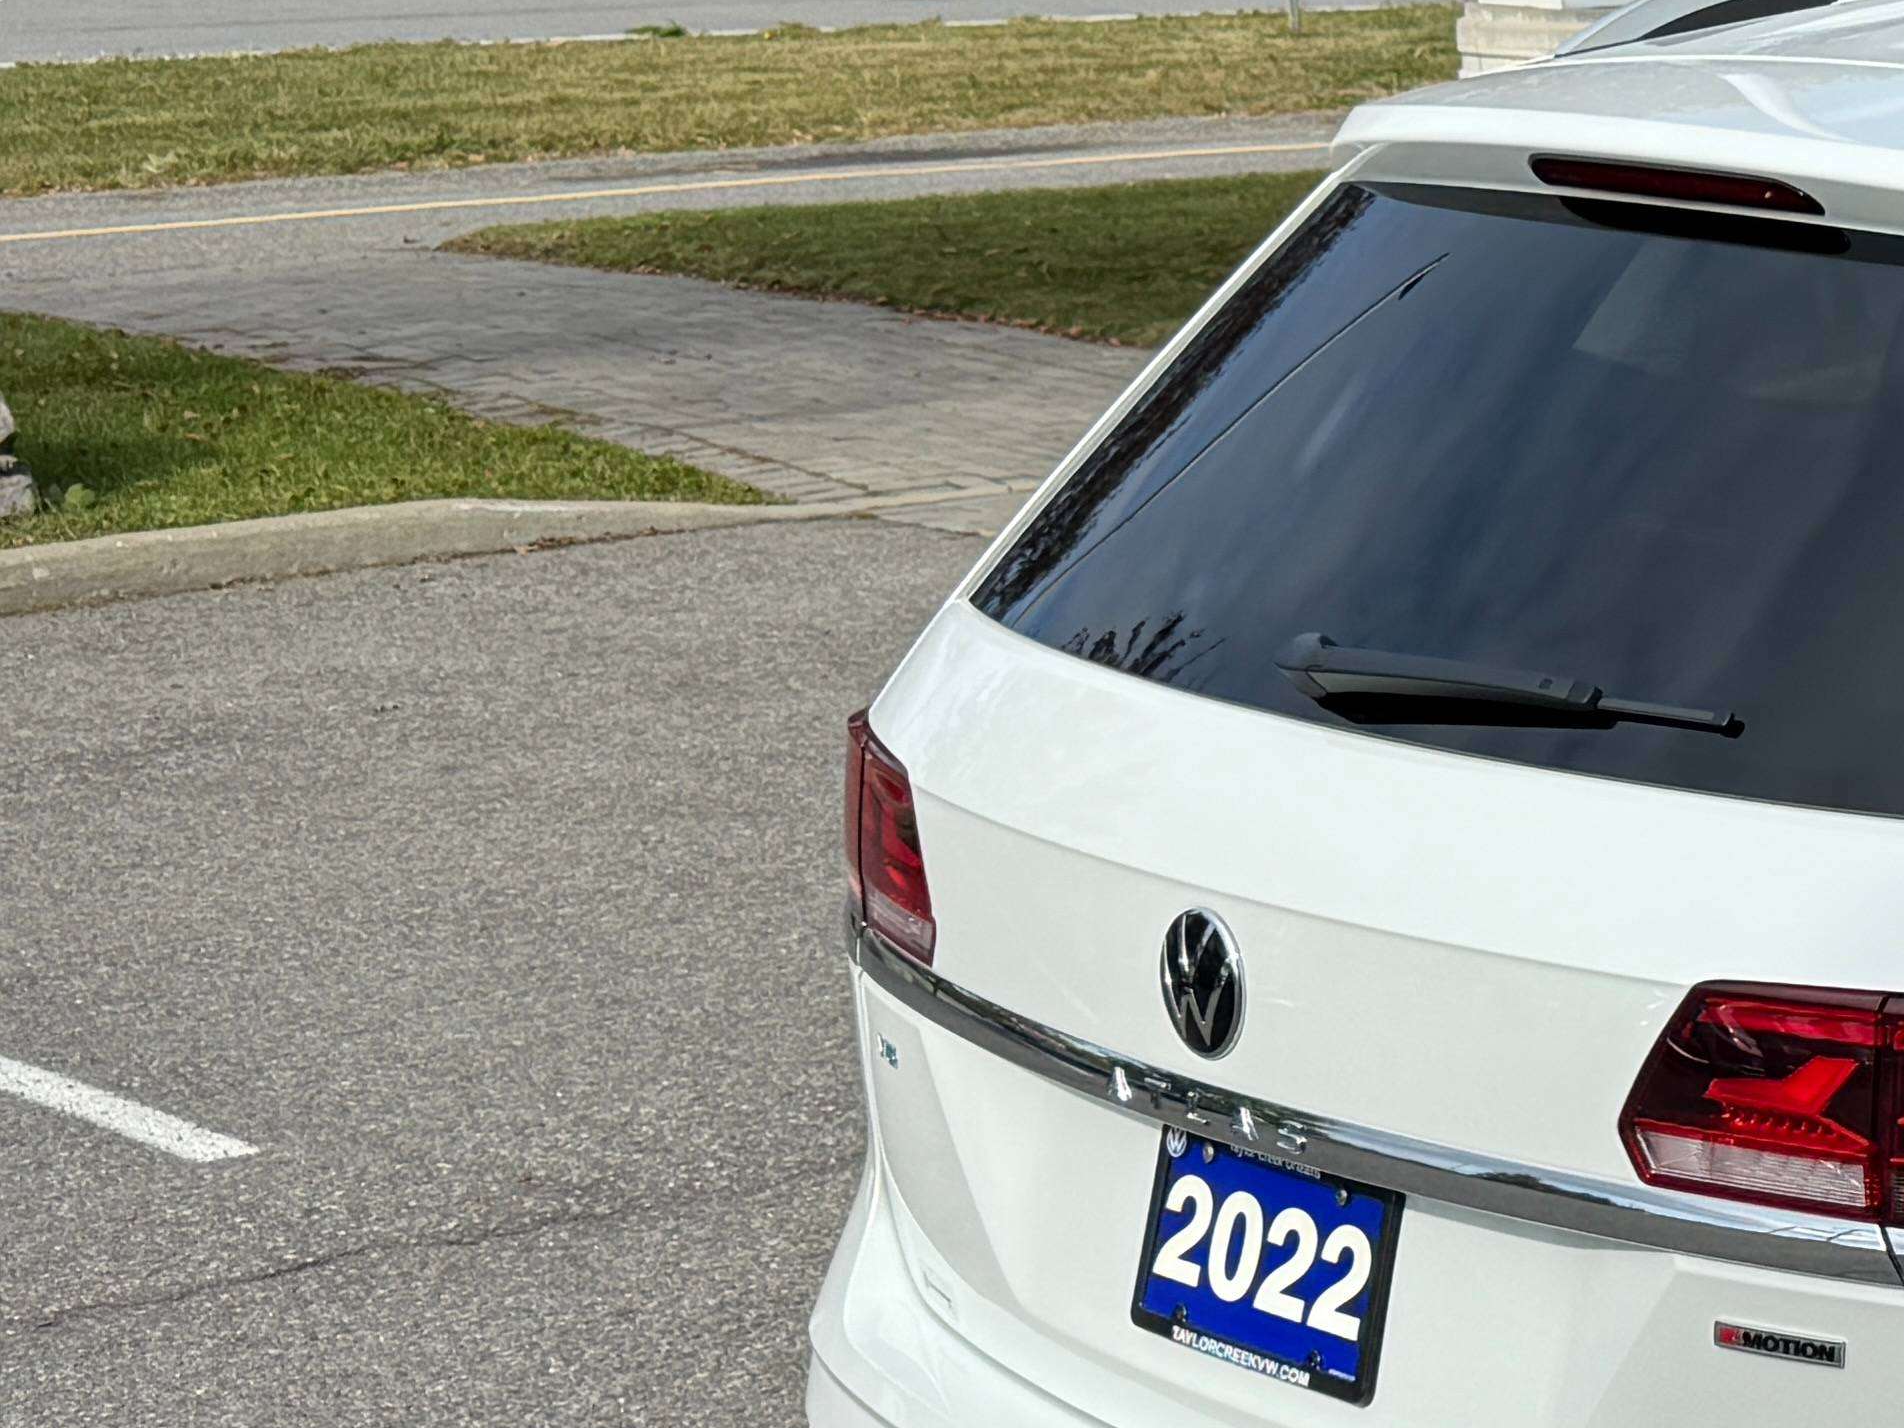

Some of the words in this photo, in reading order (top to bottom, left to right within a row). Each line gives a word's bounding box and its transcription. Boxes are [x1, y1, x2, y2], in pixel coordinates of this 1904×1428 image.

[1107, 1065, 1307, 1155] ATLAS
[1152, 1174, 1373, 1342] 2022
[1172, 1324, 1310, 1387] TAYLORCREEKVW.COM
